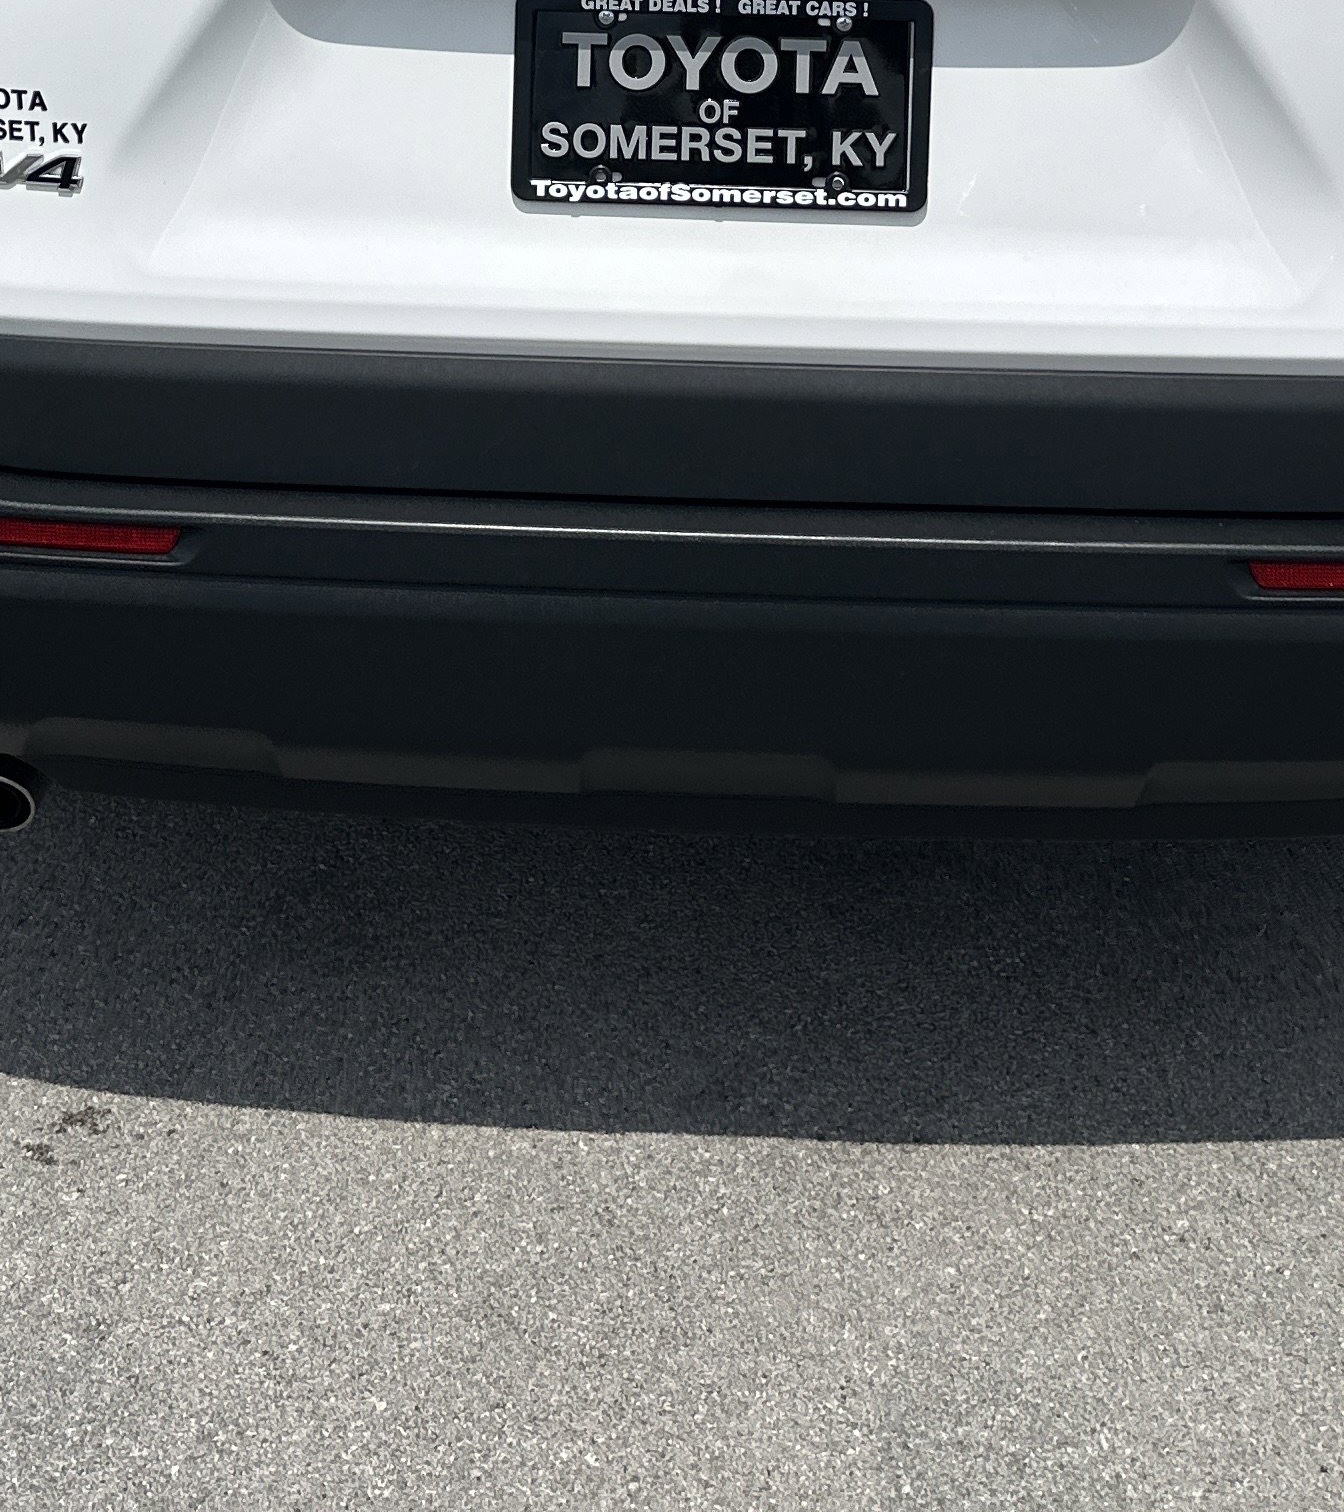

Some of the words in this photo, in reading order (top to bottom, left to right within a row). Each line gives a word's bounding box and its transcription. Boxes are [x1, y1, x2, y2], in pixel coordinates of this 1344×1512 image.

[738, 0, 800, 15] GREAT
[805, 0, 857, 16] CARS
[562, 32, 879, 96] TOYOTA
[698, 99, 740, 124] OF
[52, 121, 87, 144] KY
[541, 121, 813, 171] SOMERSET,
[831, 130, 897, 167] KY
[531, 179, 907, 207] ToyotaofSomerset.com
